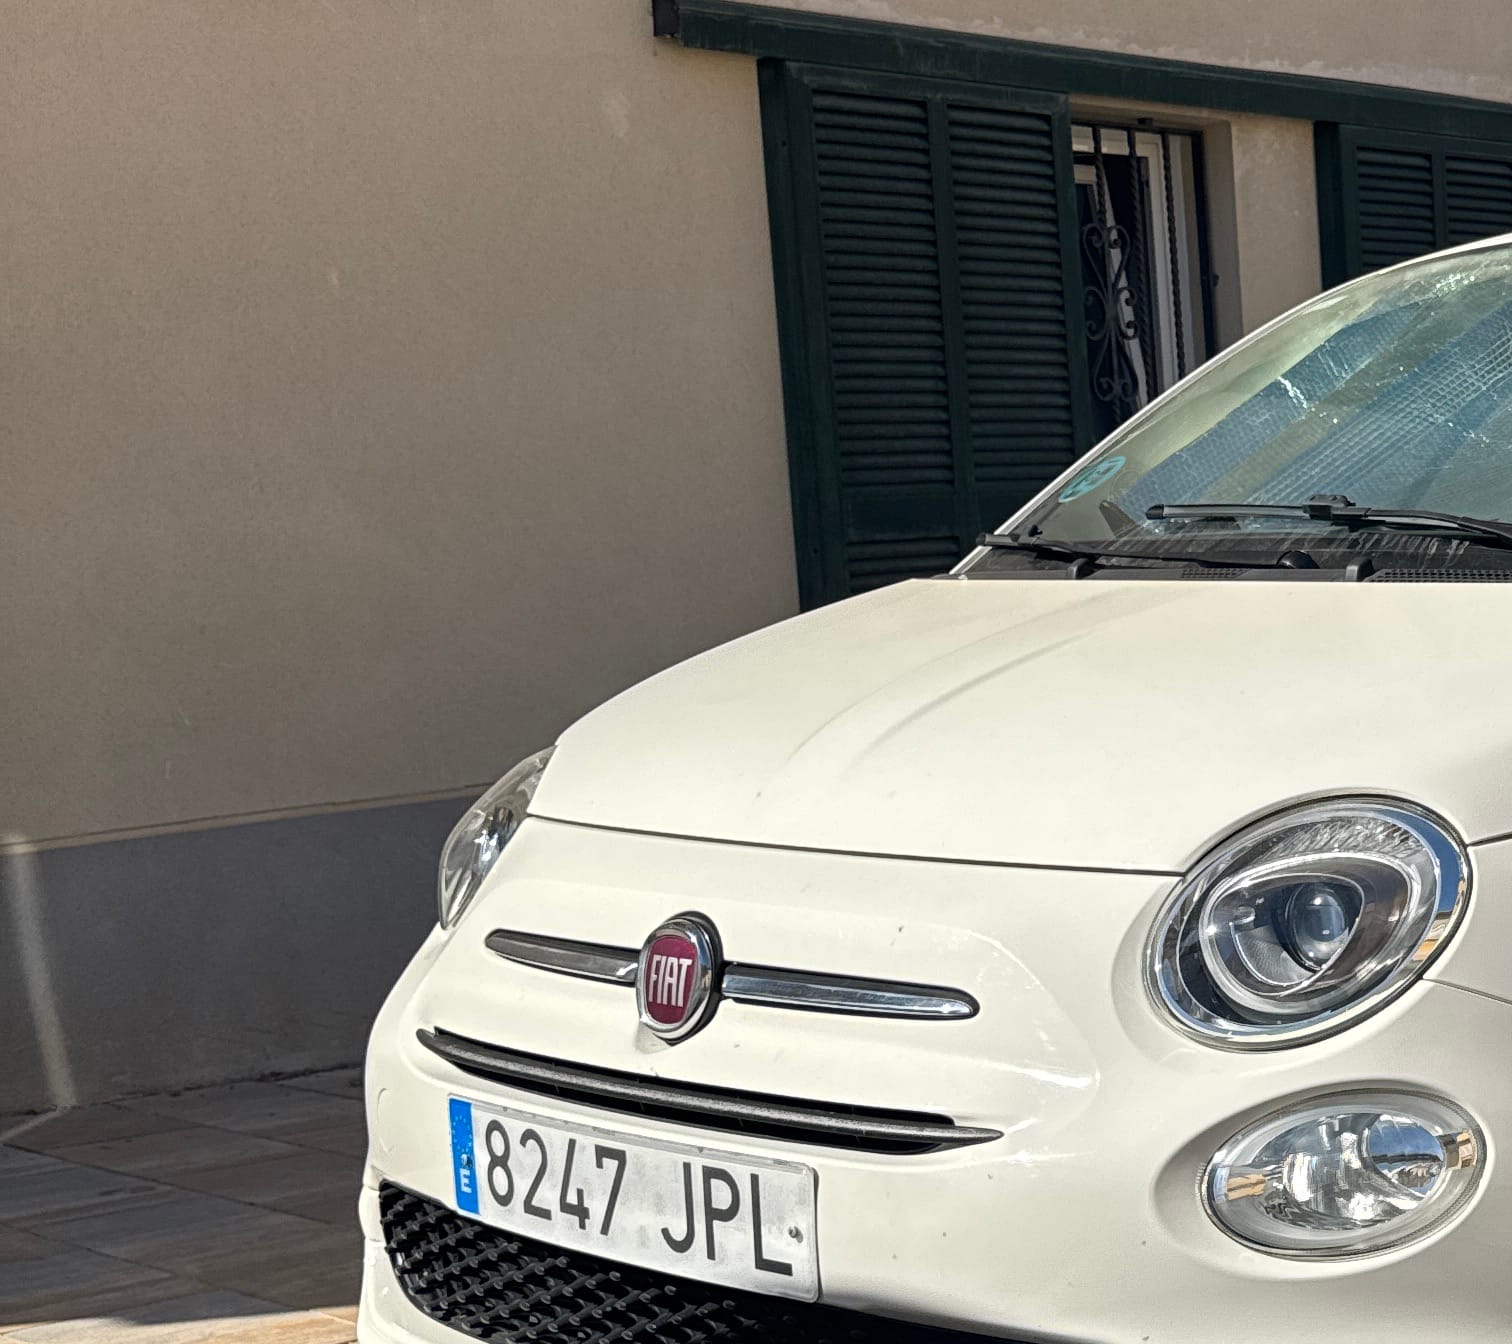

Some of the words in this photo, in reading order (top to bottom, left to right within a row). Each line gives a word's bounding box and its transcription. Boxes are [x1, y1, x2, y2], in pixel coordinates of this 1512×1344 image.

[648, 954, 693, 1007] FIAT
[460, 1168, 473, 1194] E
[485, 1119, 627, 1237] 8247
[661, 1161, 794, 1277] JPL
